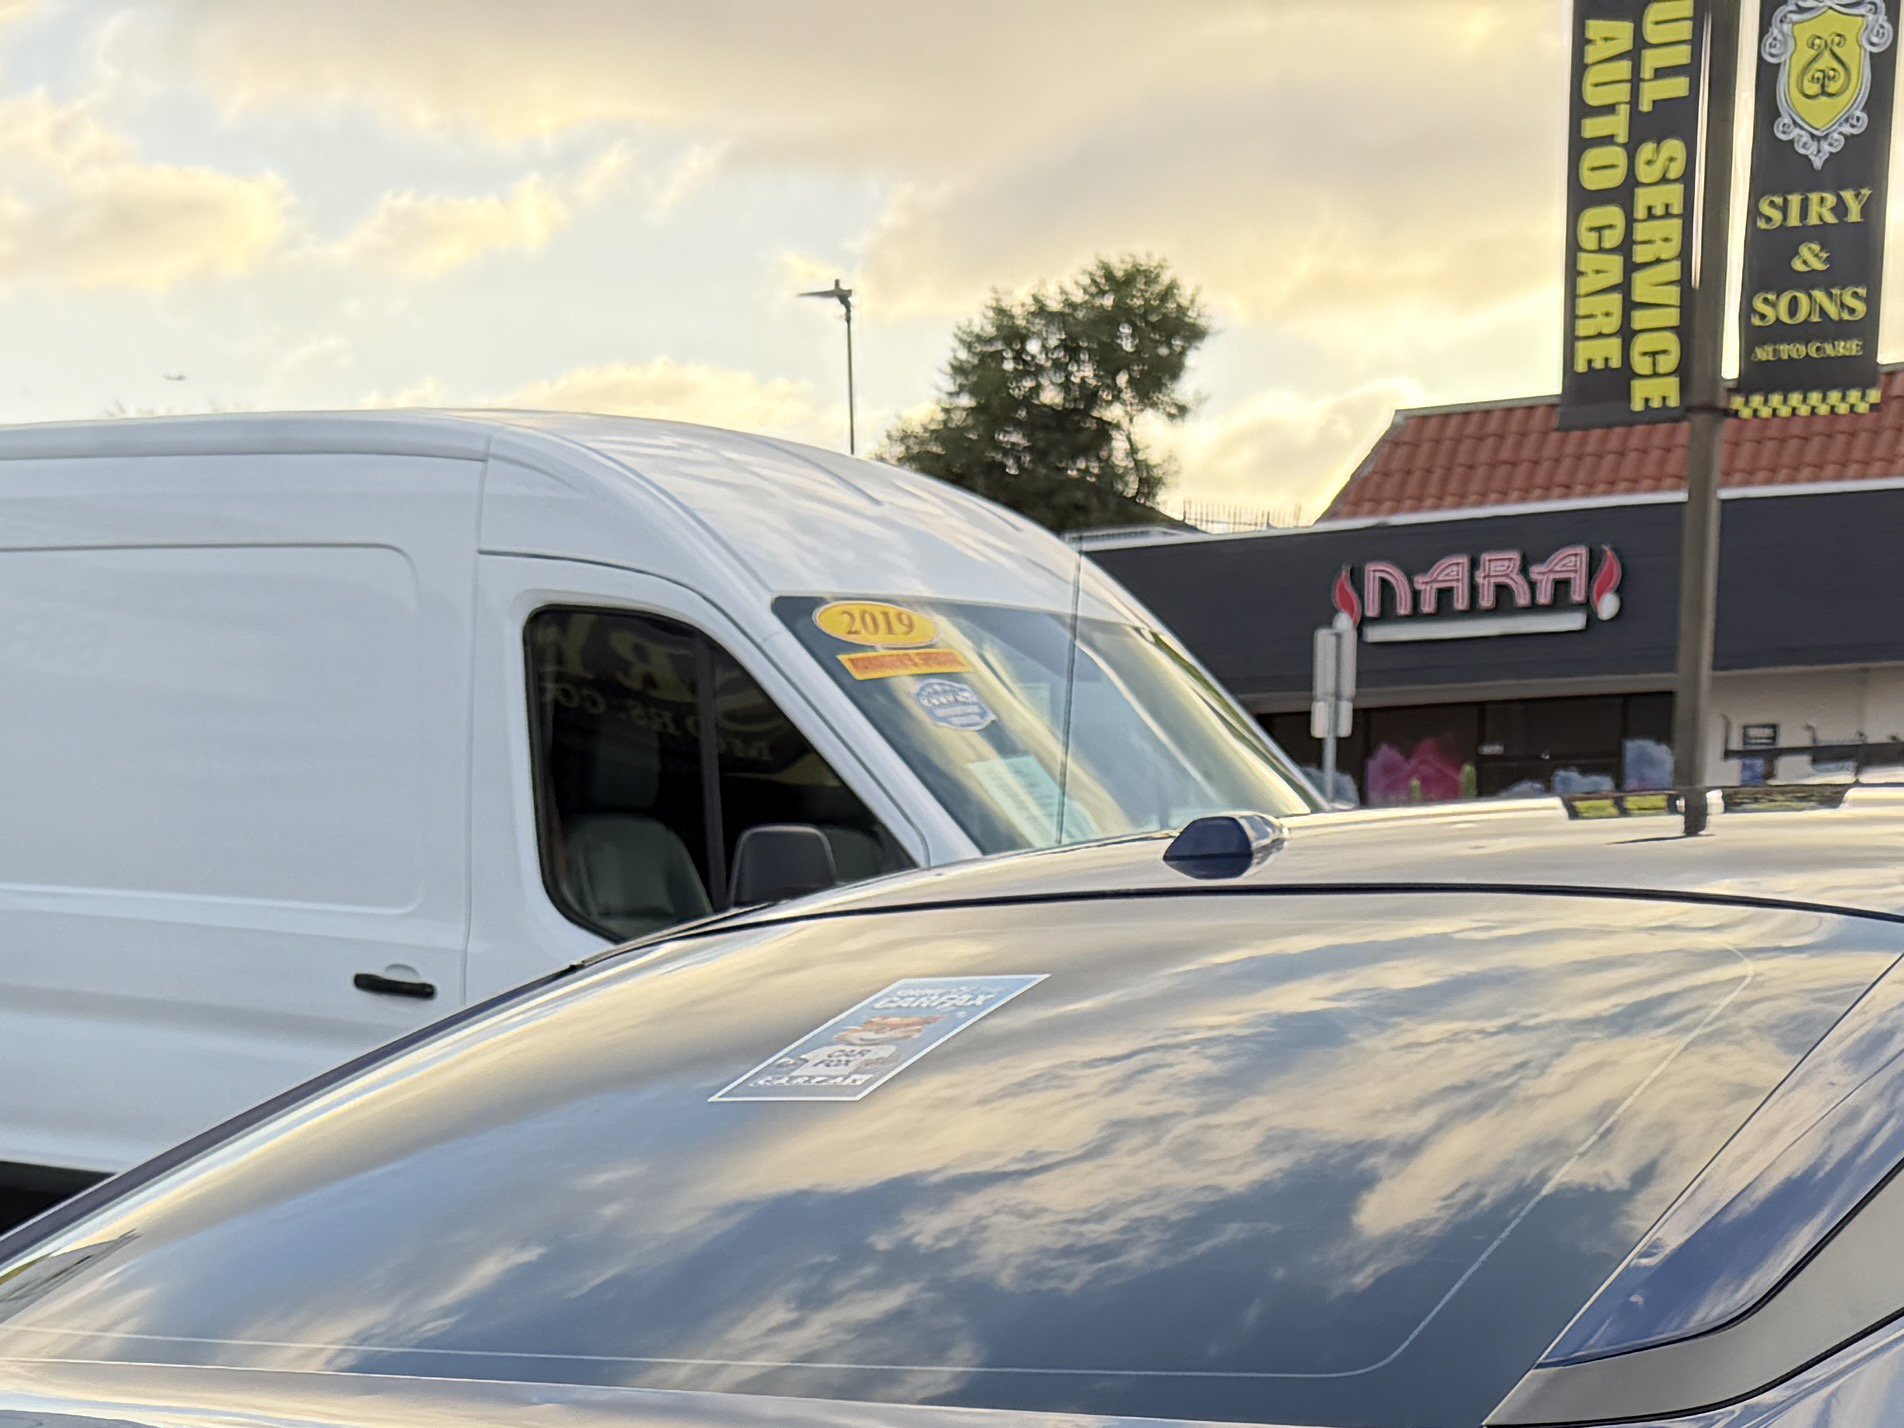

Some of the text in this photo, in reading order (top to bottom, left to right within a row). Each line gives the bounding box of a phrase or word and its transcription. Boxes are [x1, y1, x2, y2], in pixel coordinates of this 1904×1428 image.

[1574, 19, 1634, 374] AUTO CARE
[1756, 187, 1873, 230] SIRY
[1630, 138, 1687, 412] SERVICE
[1790, 241, 1831, 273] &
[1751, 285, 1868, 327] SONS
[1363, 544, 1590, 619] NARA
[841, 609, 916, 636] 2019
